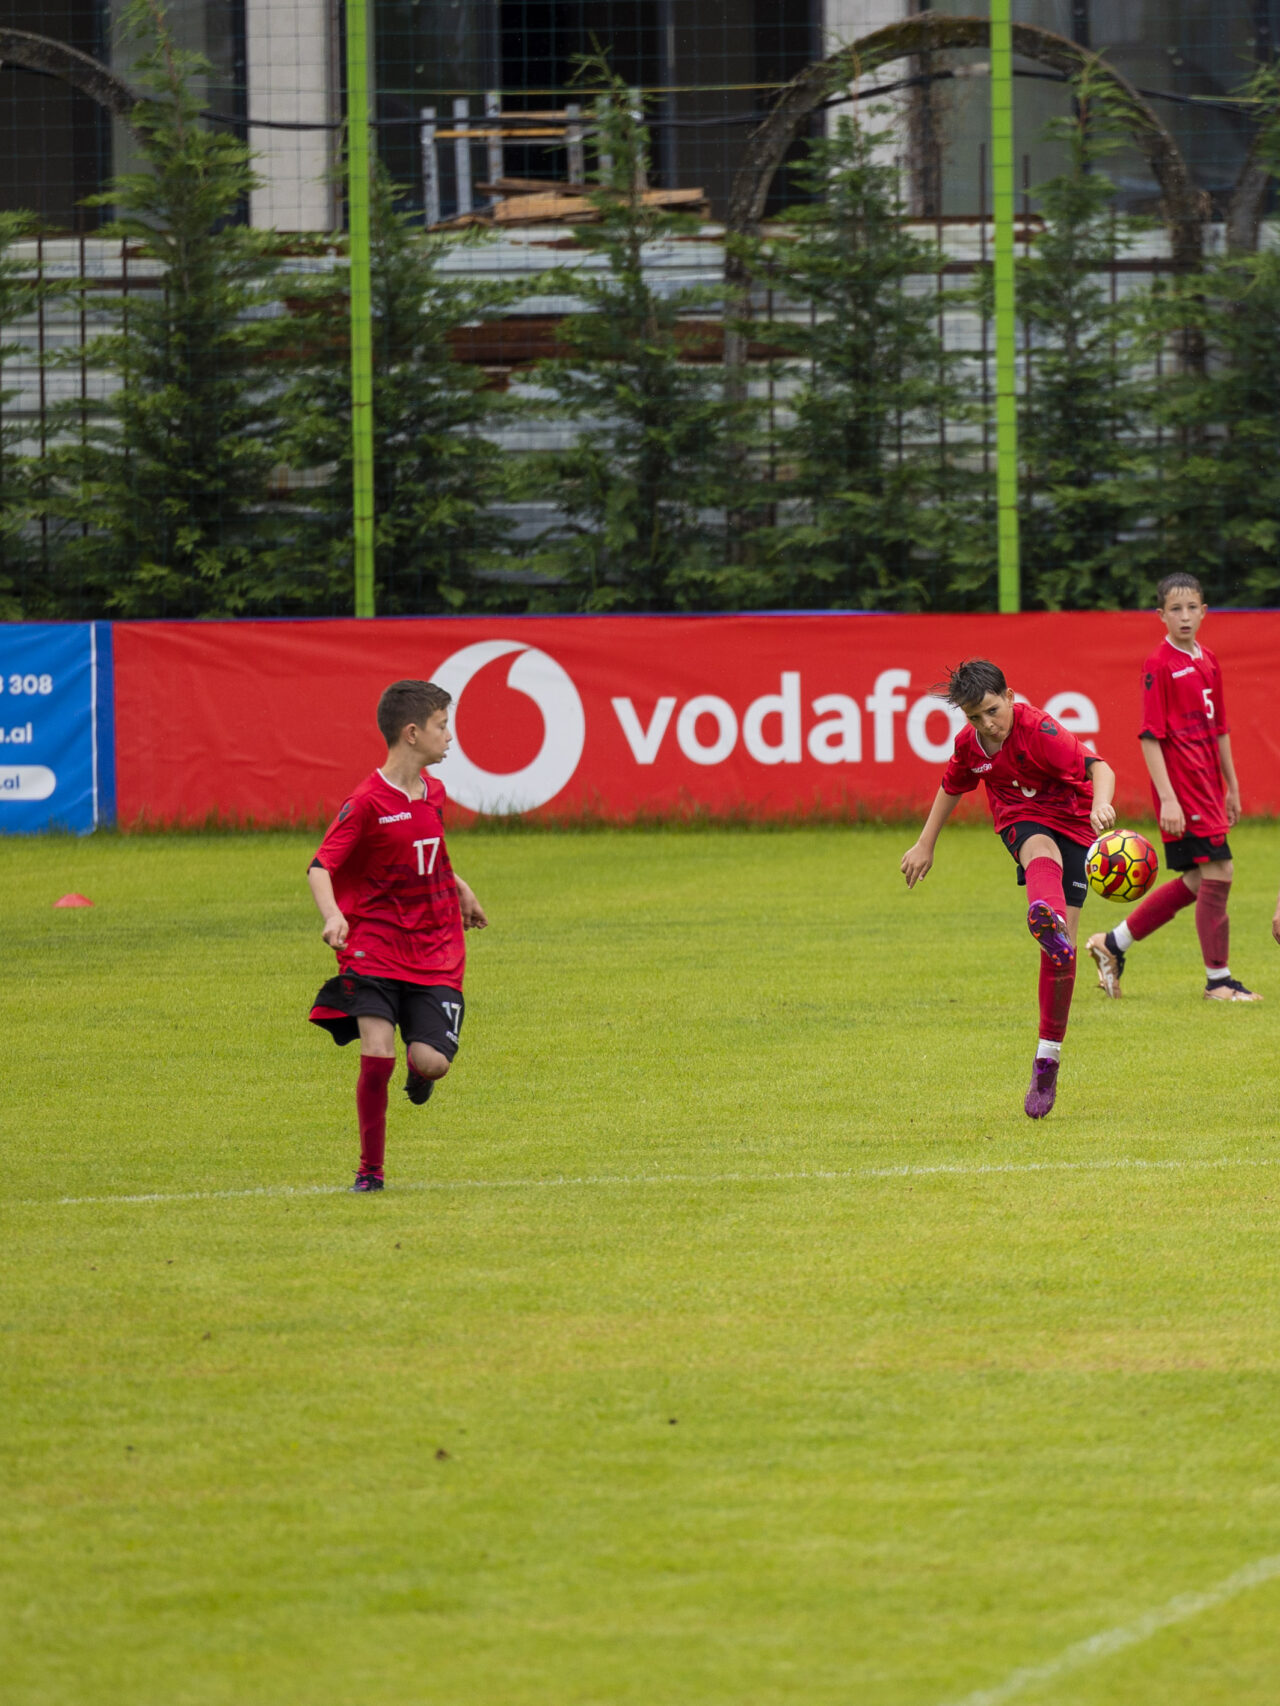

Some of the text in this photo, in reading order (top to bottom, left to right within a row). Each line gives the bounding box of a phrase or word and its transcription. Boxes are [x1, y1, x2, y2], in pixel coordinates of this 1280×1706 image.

[9, 674, 53, 695] 308
[611, 669, 1100, 765] vodafoe
[1202, 688, 1215, 719] 5
[412, 836, 441, 876] 17
[441, 1001, 463, 1035] 17
